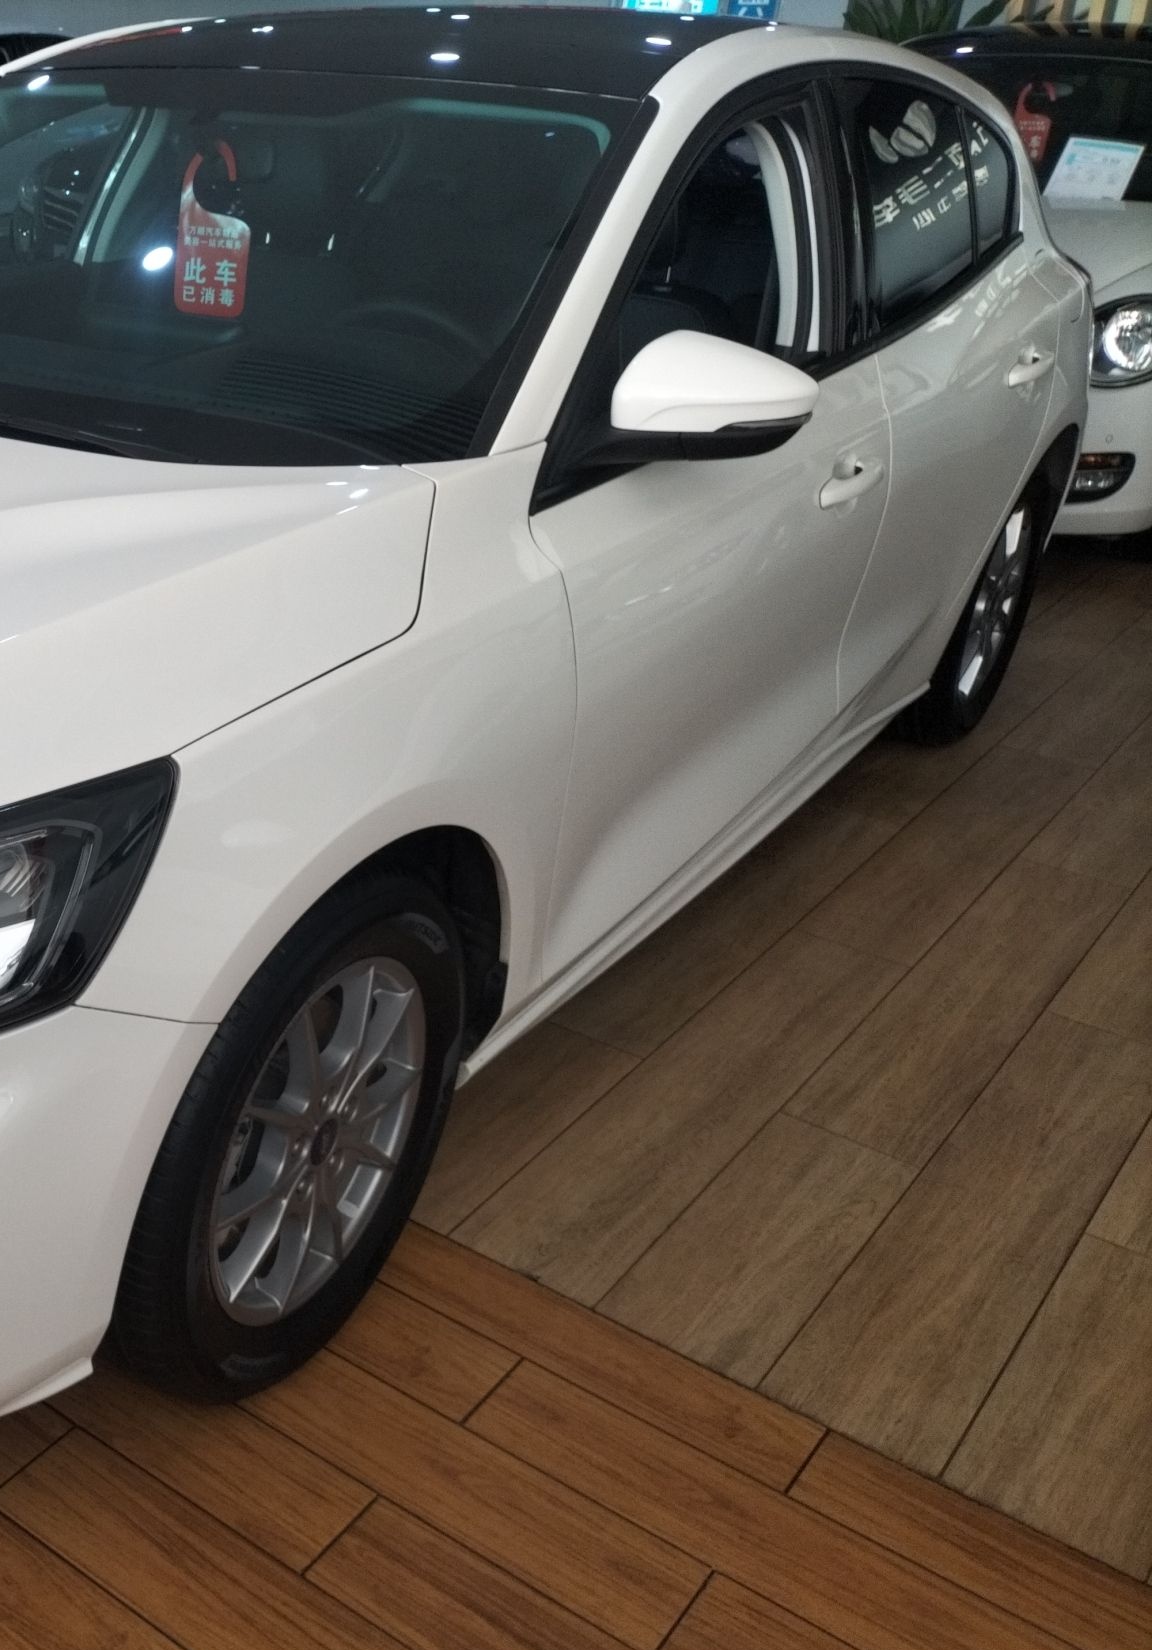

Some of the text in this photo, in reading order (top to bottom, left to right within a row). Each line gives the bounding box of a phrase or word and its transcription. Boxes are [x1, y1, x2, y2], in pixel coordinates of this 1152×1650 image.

[183, 257, 238, 287] 此车
[182, 285, 236, 308] 已消毒
